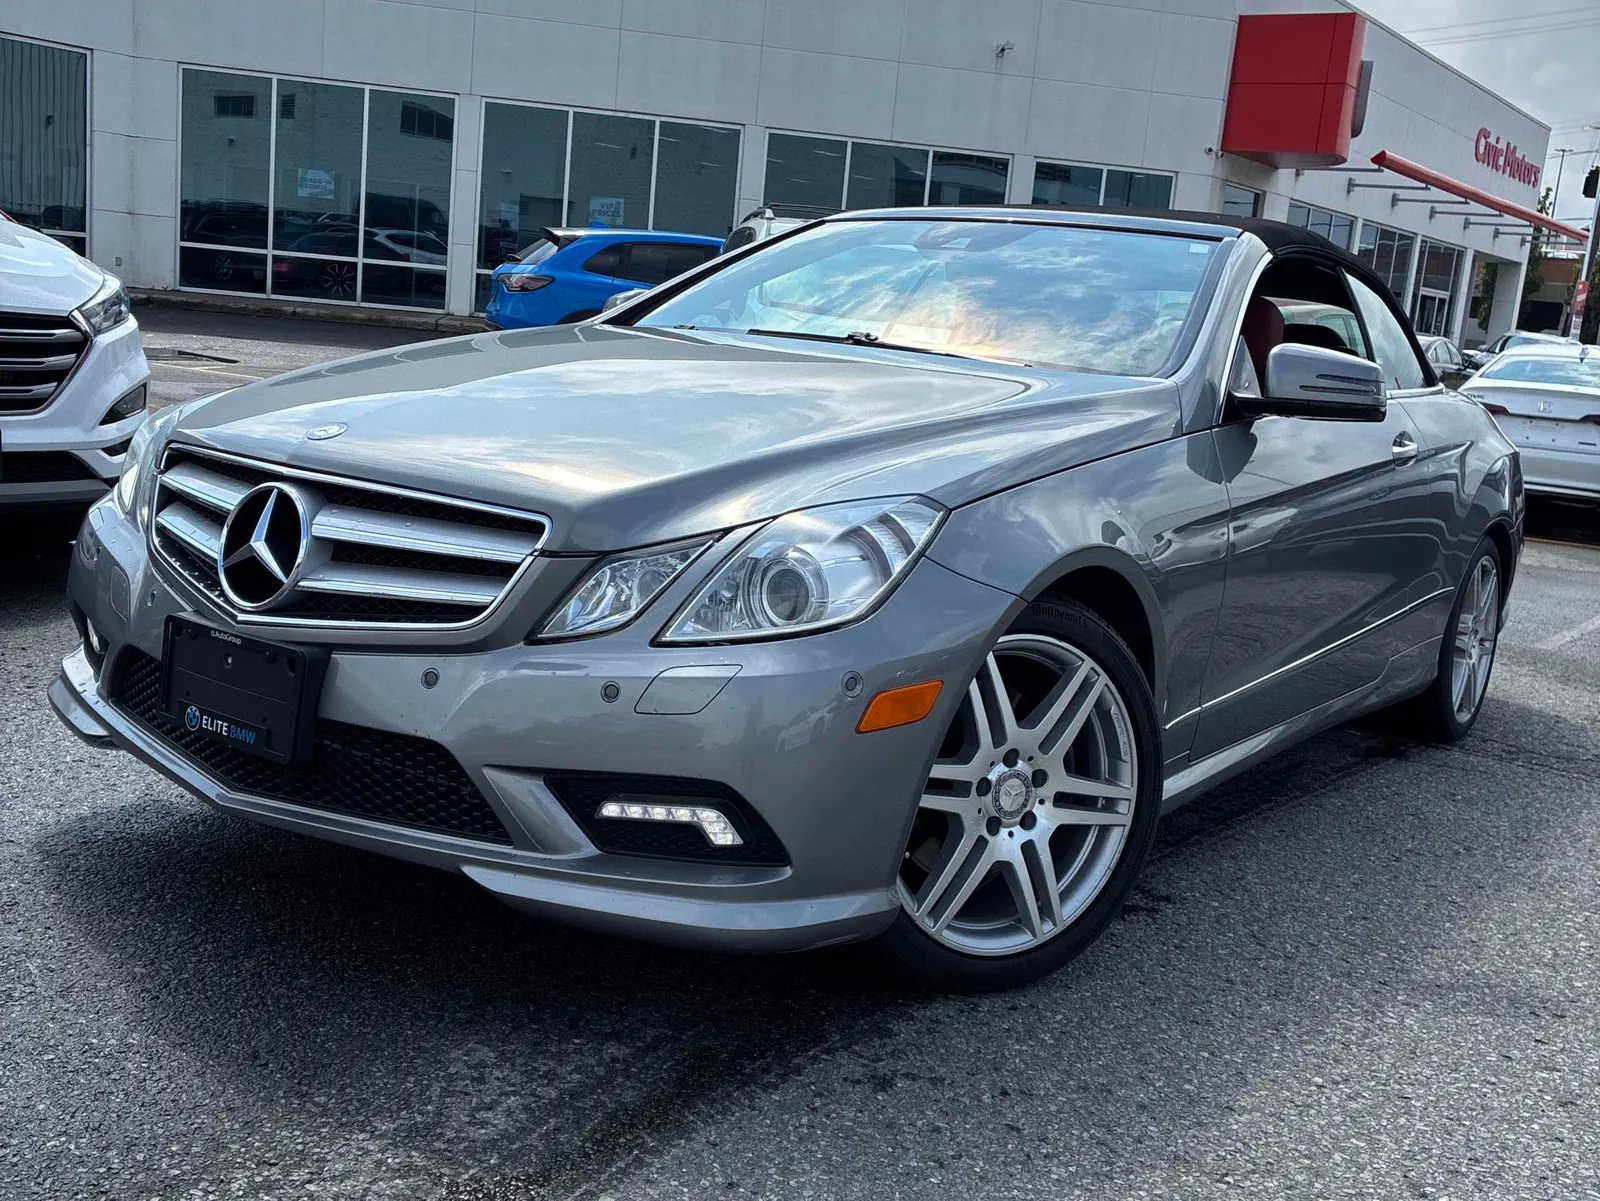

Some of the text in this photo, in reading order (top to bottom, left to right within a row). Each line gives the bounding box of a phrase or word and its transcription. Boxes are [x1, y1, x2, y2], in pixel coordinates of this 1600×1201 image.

[1475, 127, 1541, 188] Civic Motors
[591, 209, 621, 218] PRICES
[1032, 603, 1081, 625] Continental
[201, 715, 257, 744] ELITE BMW
